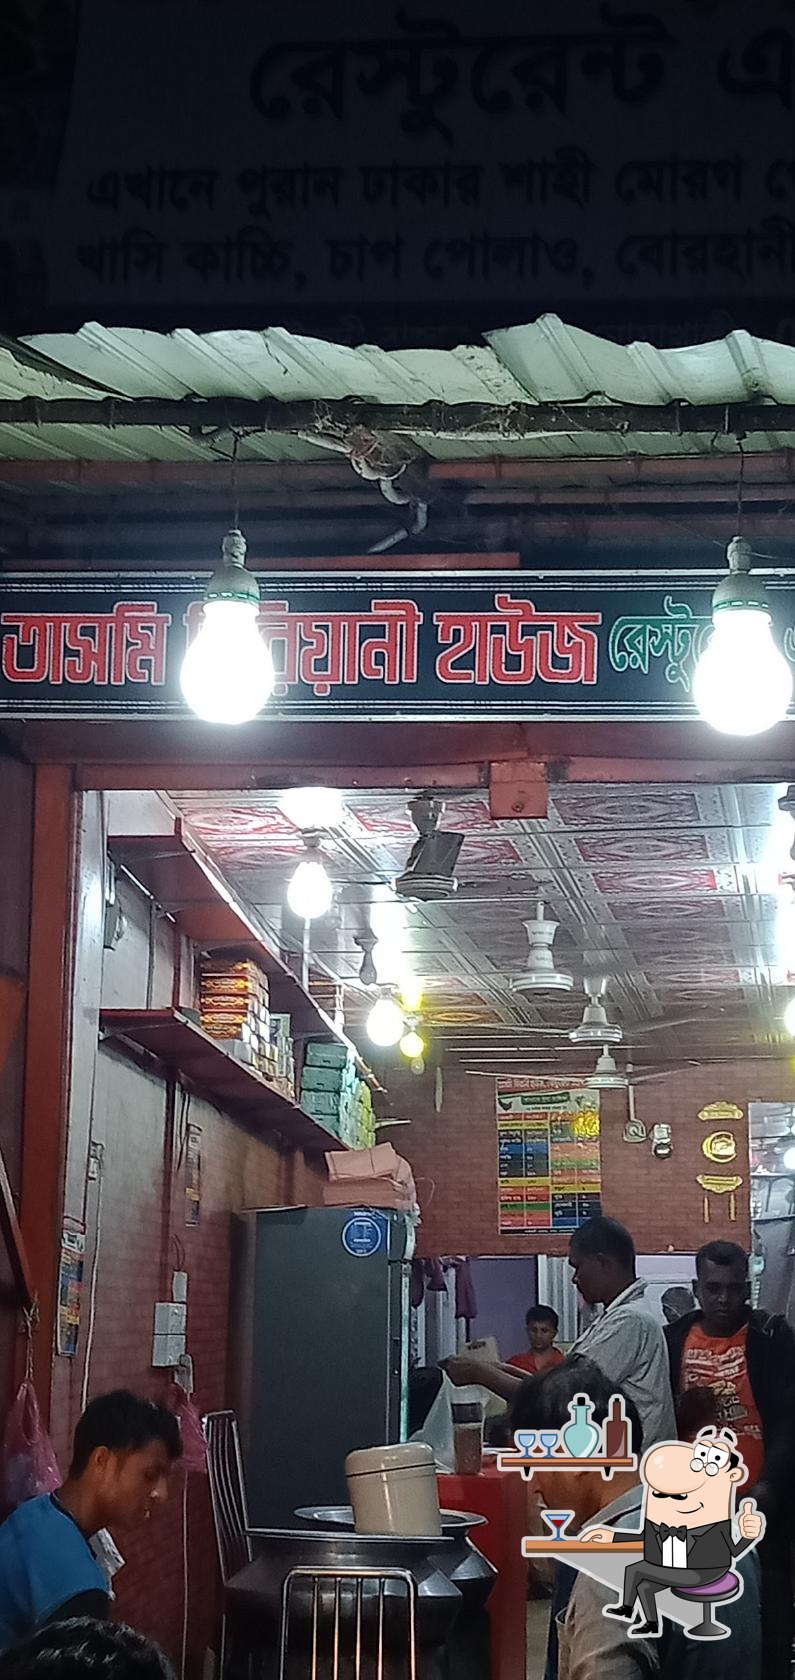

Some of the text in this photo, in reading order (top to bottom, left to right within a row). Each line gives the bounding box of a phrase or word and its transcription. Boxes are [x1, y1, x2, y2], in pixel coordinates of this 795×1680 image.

[249, 2, 678, 147] রেস্টুরেন্ট
[86, 164, 219, 212] এখানে
[236, 163, 345, 221] পুরান
[358, 159, 484, 208] ঢাকার
[499, 146, 599, 208] শাহী
[616, 153, 745, 206] মোরগ
[74, 226, 168, 284] খাসি
[321, 232, 408, 281] চাপ
[423, 228, 593, 290] পোলাও,
[2, 600, 171, 688] তাসমি
[433, 594, 602, 686] হাউজ
